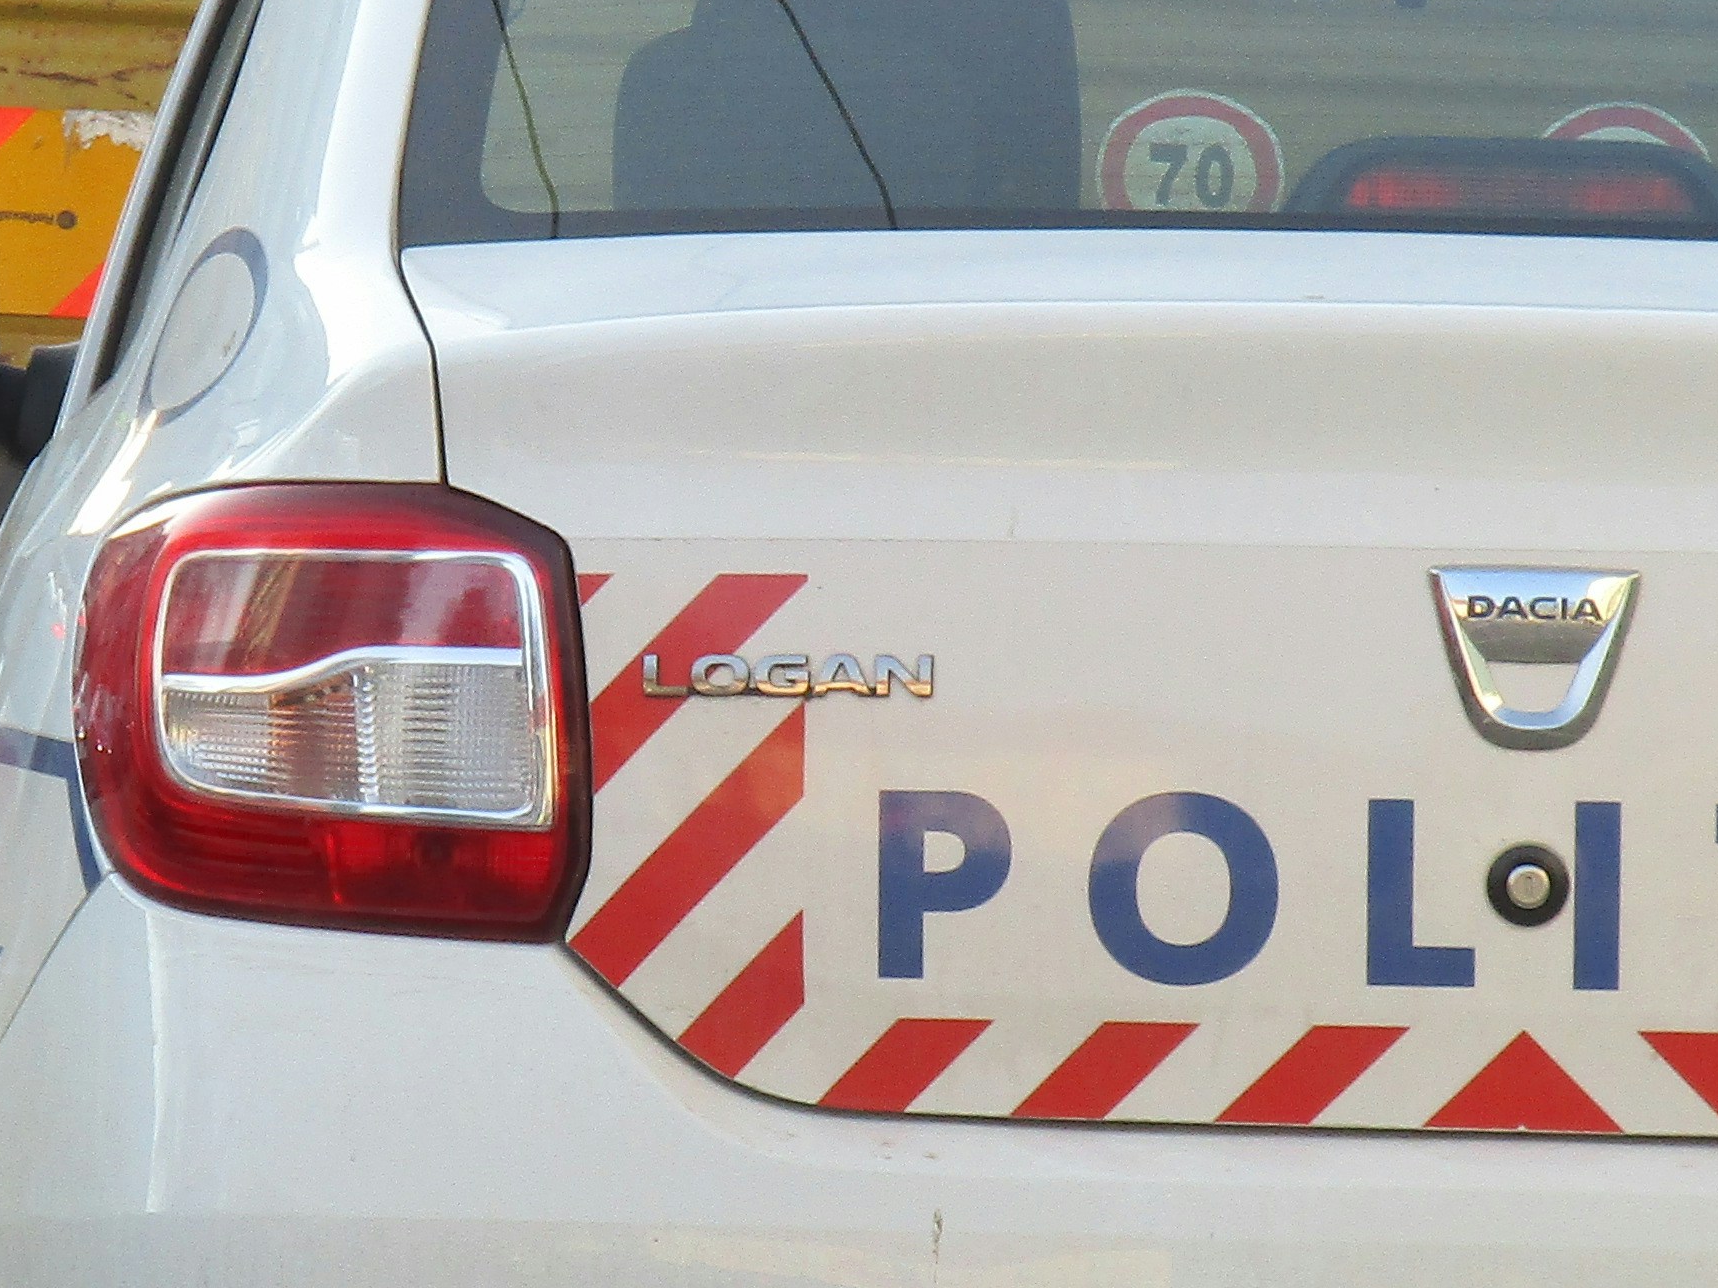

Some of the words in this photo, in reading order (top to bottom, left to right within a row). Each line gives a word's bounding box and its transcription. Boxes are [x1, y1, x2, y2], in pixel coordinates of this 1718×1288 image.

[1149, 143, 1235, 208] 70
[1466, 595, 1603, 621] DACIA
[642, 653, 935, 698] LOGAN
